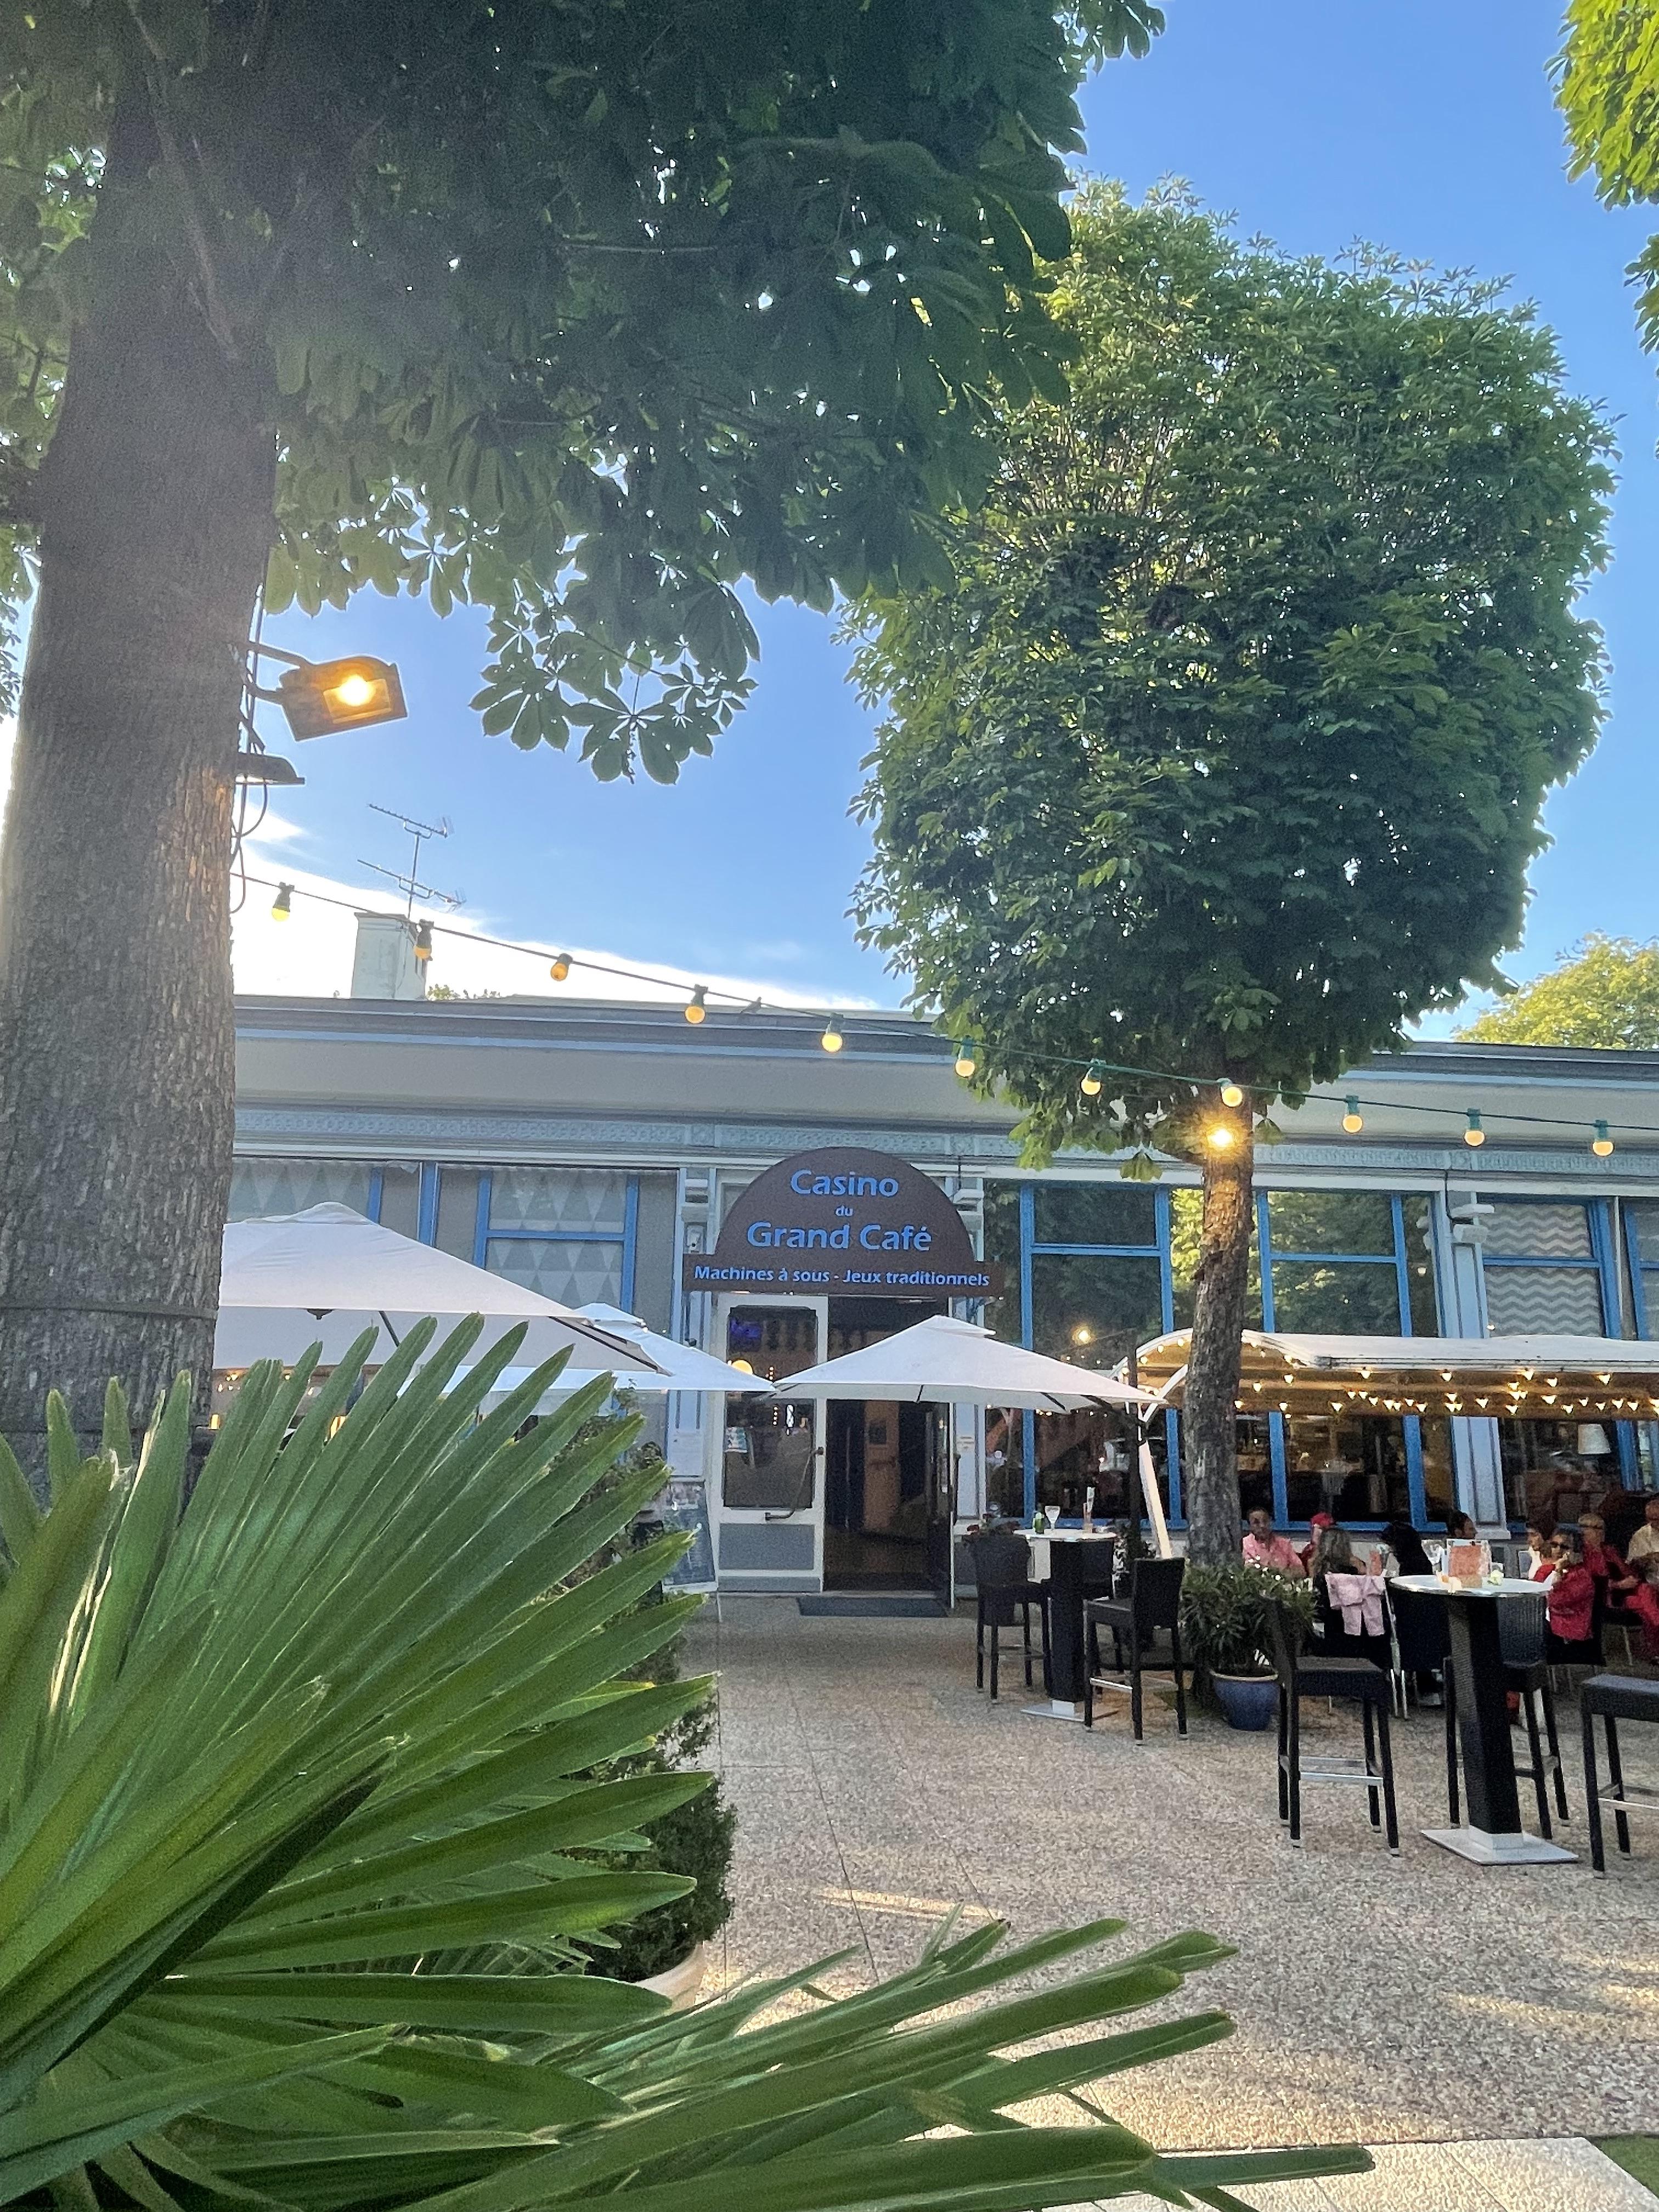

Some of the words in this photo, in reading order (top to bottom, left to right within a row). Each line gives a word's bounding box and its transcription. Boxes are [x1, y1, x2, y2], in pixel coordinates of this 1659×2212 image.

[791, 1169, 898, 1197] Casino
[835, 1205, 854, 1217] du
[747, 1221, 850, 1249] Grand
[860, 1224, 933, 1251] Café
[695, 1266, 773, 1280] Machines
[777, 1267, 788, 1281] à
[792, 1269, 830, 1282] sous
[843, 1269, 881, 1283] Jeux
[886, 1270, 990, 1286] traditionnels
